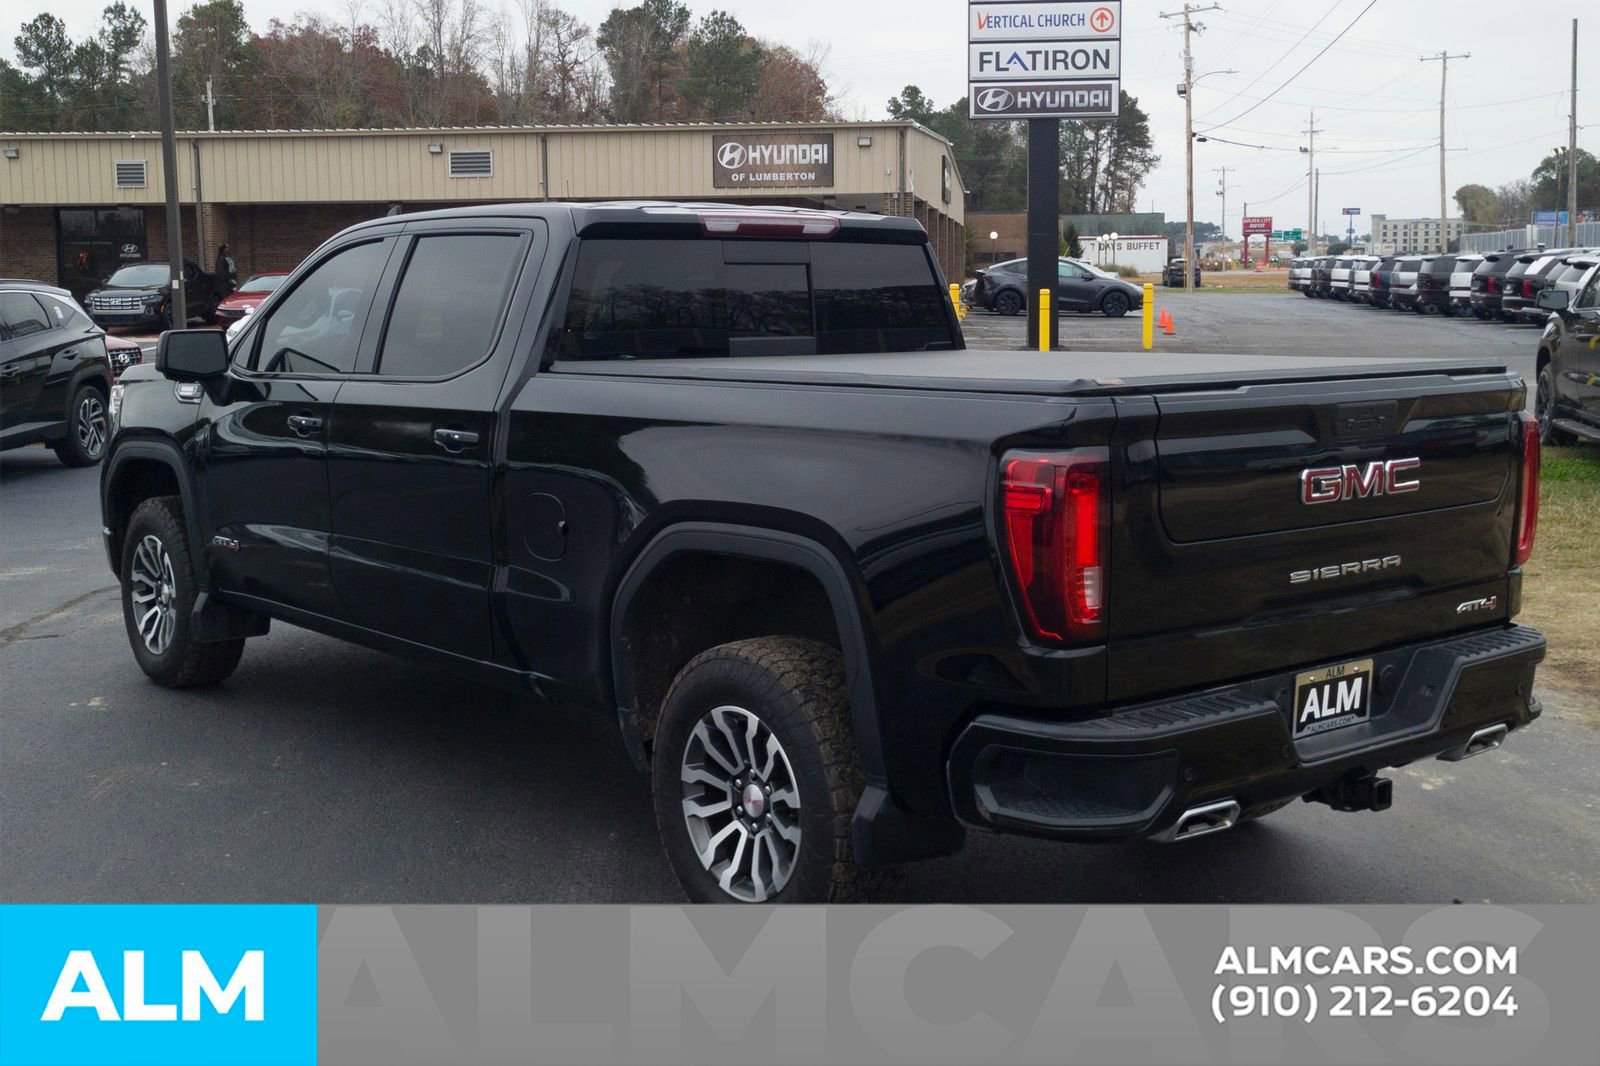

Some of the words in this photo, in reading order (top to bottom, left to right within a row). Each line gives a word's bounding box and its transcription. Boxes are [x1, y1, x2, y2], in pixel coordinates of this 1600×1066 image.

[977, 11, 1034, 30] VERTICAL
[1037, 13, 1085, 27] CHURCH
[979, 49, 1110, 72] FLATIRON
[1017, 89, 1109, 108] HYUNDAI
[748, 143, 828, 165] HYUNDAI
[731, 173, 746, 181] OF
[749, 172, 816, 181] LUMBERTON
[1099, 242, 1122, 251] DAYS
[1127, 242, 1160, 251] BUFFET
[1301, 456, 1421, 505] GMC
[1289, 555, 1402, 584] SIERRA
[1456, 595, 1497, 614] AT4
[1325, 665, 1345, 679] ALM
[1299, 677, 1363, 723] ALM
